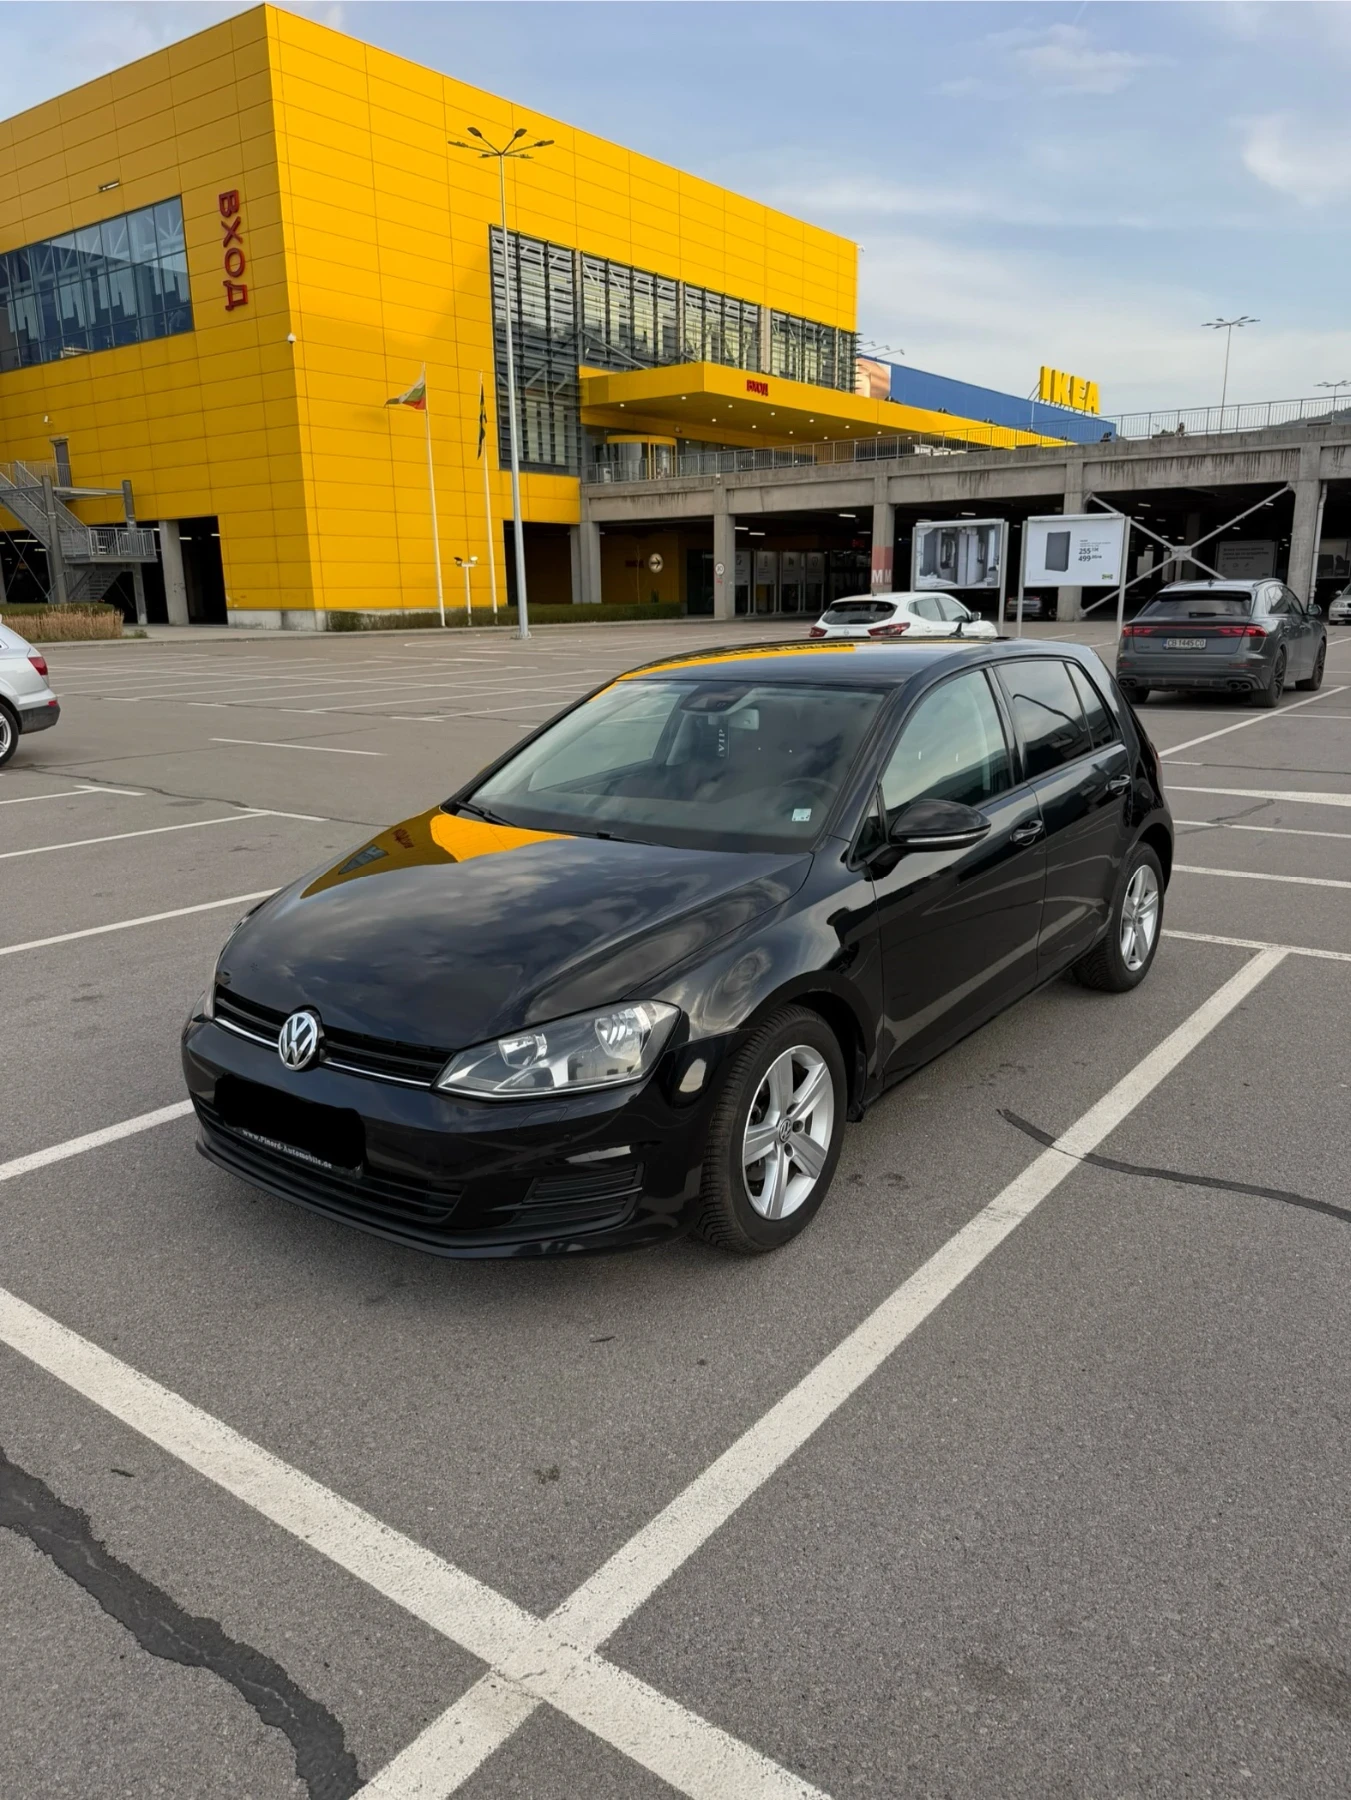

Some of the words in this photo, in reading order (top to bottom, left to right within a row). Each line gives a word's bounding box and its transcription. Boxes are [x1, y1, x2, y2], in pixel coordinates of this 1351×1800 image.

[219, 190, 249, 312] ВХОД
[746, 379, 769, 397] ВХОД
[1040, 366, 1099, 415] IKEA
[1078, 547, 1091, 555] 255
[1168, 639, 1177, 648] CB
